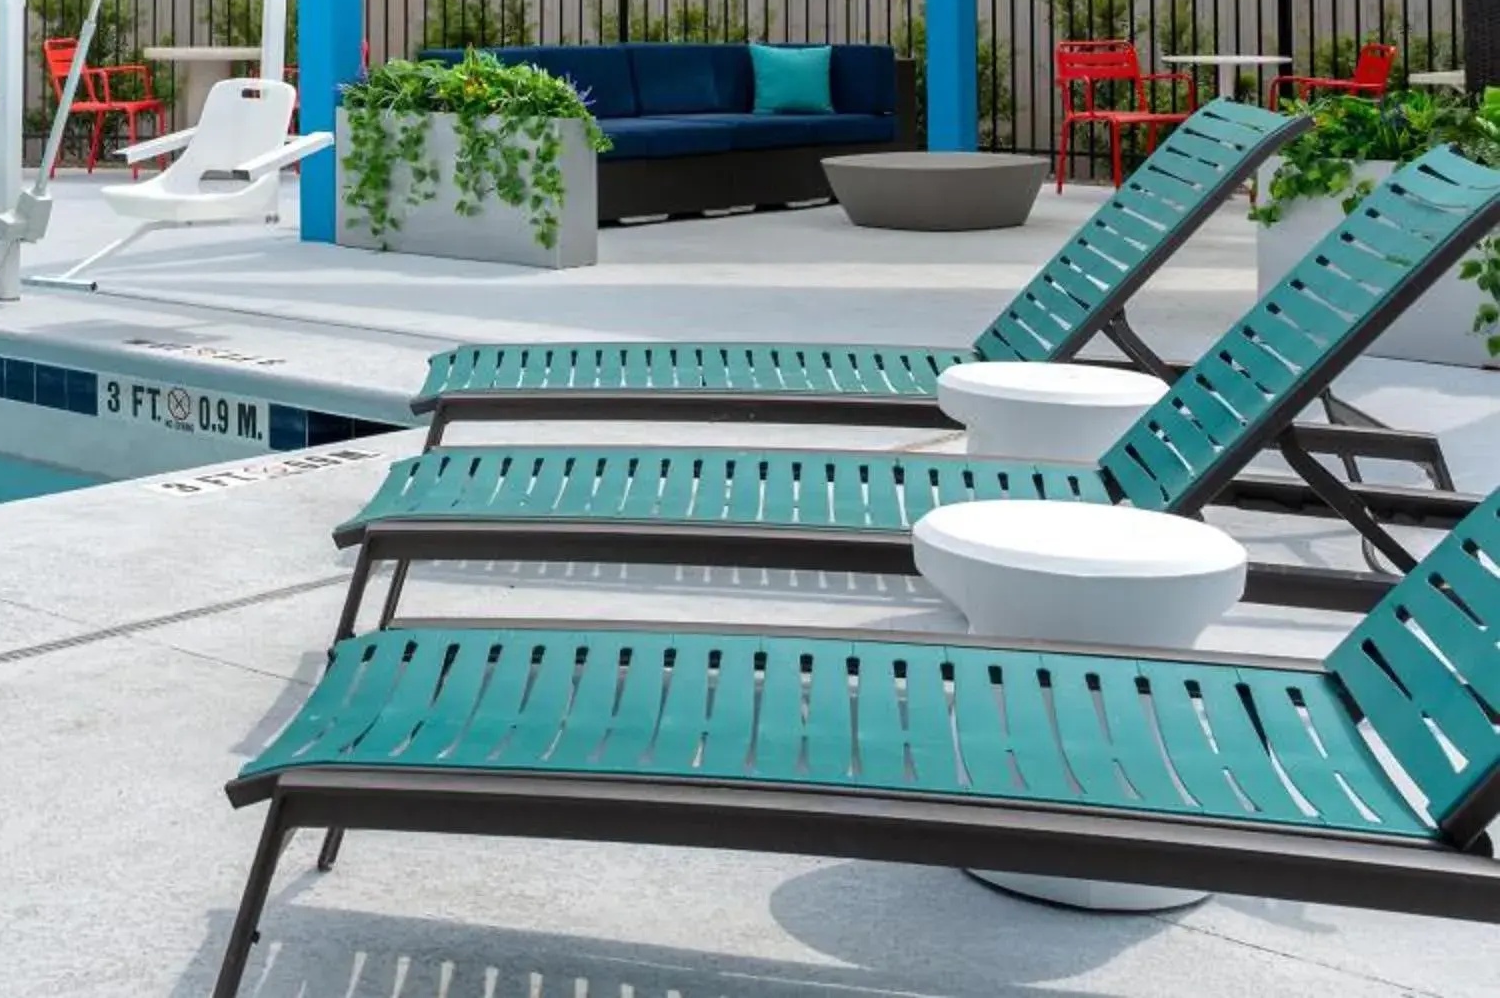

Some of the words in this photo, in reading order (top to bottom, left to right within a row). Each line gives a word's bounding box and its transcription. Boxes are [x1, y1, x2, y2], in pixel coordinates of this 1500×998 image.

[107, 381, 121, 412] 3
[132, 384, 161, 421] FT.
[199, 395, 229, 434] 0.9
[237, 402, 263, 441] M.
